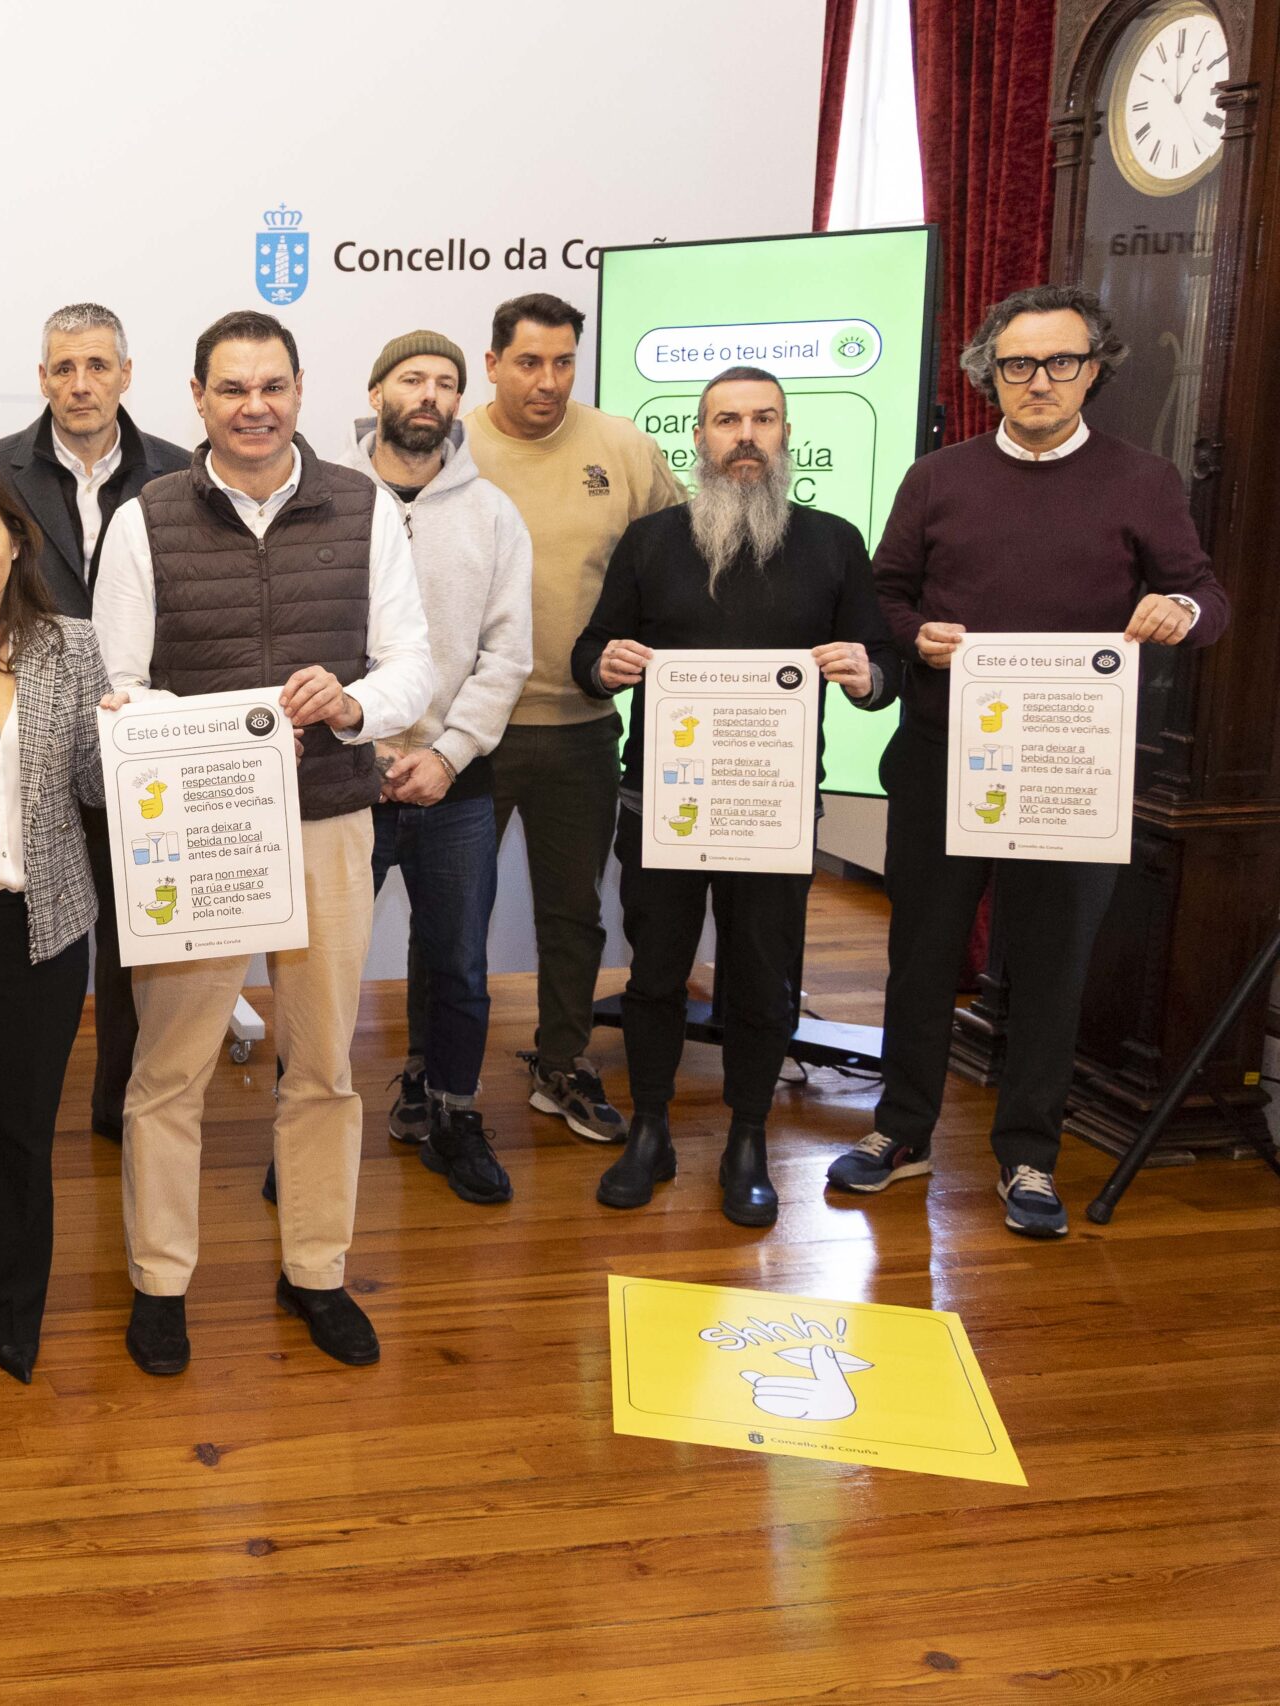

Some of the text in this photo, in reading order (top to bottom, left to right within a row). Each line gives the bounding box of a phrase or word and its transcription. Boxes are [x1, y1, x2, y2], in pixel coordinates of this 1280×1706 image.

[333, 239, 490, 272] Concello
[504, 238, 547, 270] da
[656, 340, 819, 363] Este é o teu sinal
[976, 654, 1085, 666] Este é o teu sinal
[669, 671, 770, 682] Este é o teu sinal
[127, 718, 239, 742] Este é o teu sinal
[1019, 804, 1038, 813] WC
[1040, 806, 1071, 814] cando
[709, 828, 756, 837] pola noite.
[189, 867, 268, 884] para non mexar
[190, 886, 204, 894] na
[205, 882, 222, 892] rúa
[232, 881, 254, 889] usar
[191, 891, 271, 906] WC cando saes
[193, 906, 244, 920] pola noite.
[770, 1436, 879, 1456] Concello da Coruña
